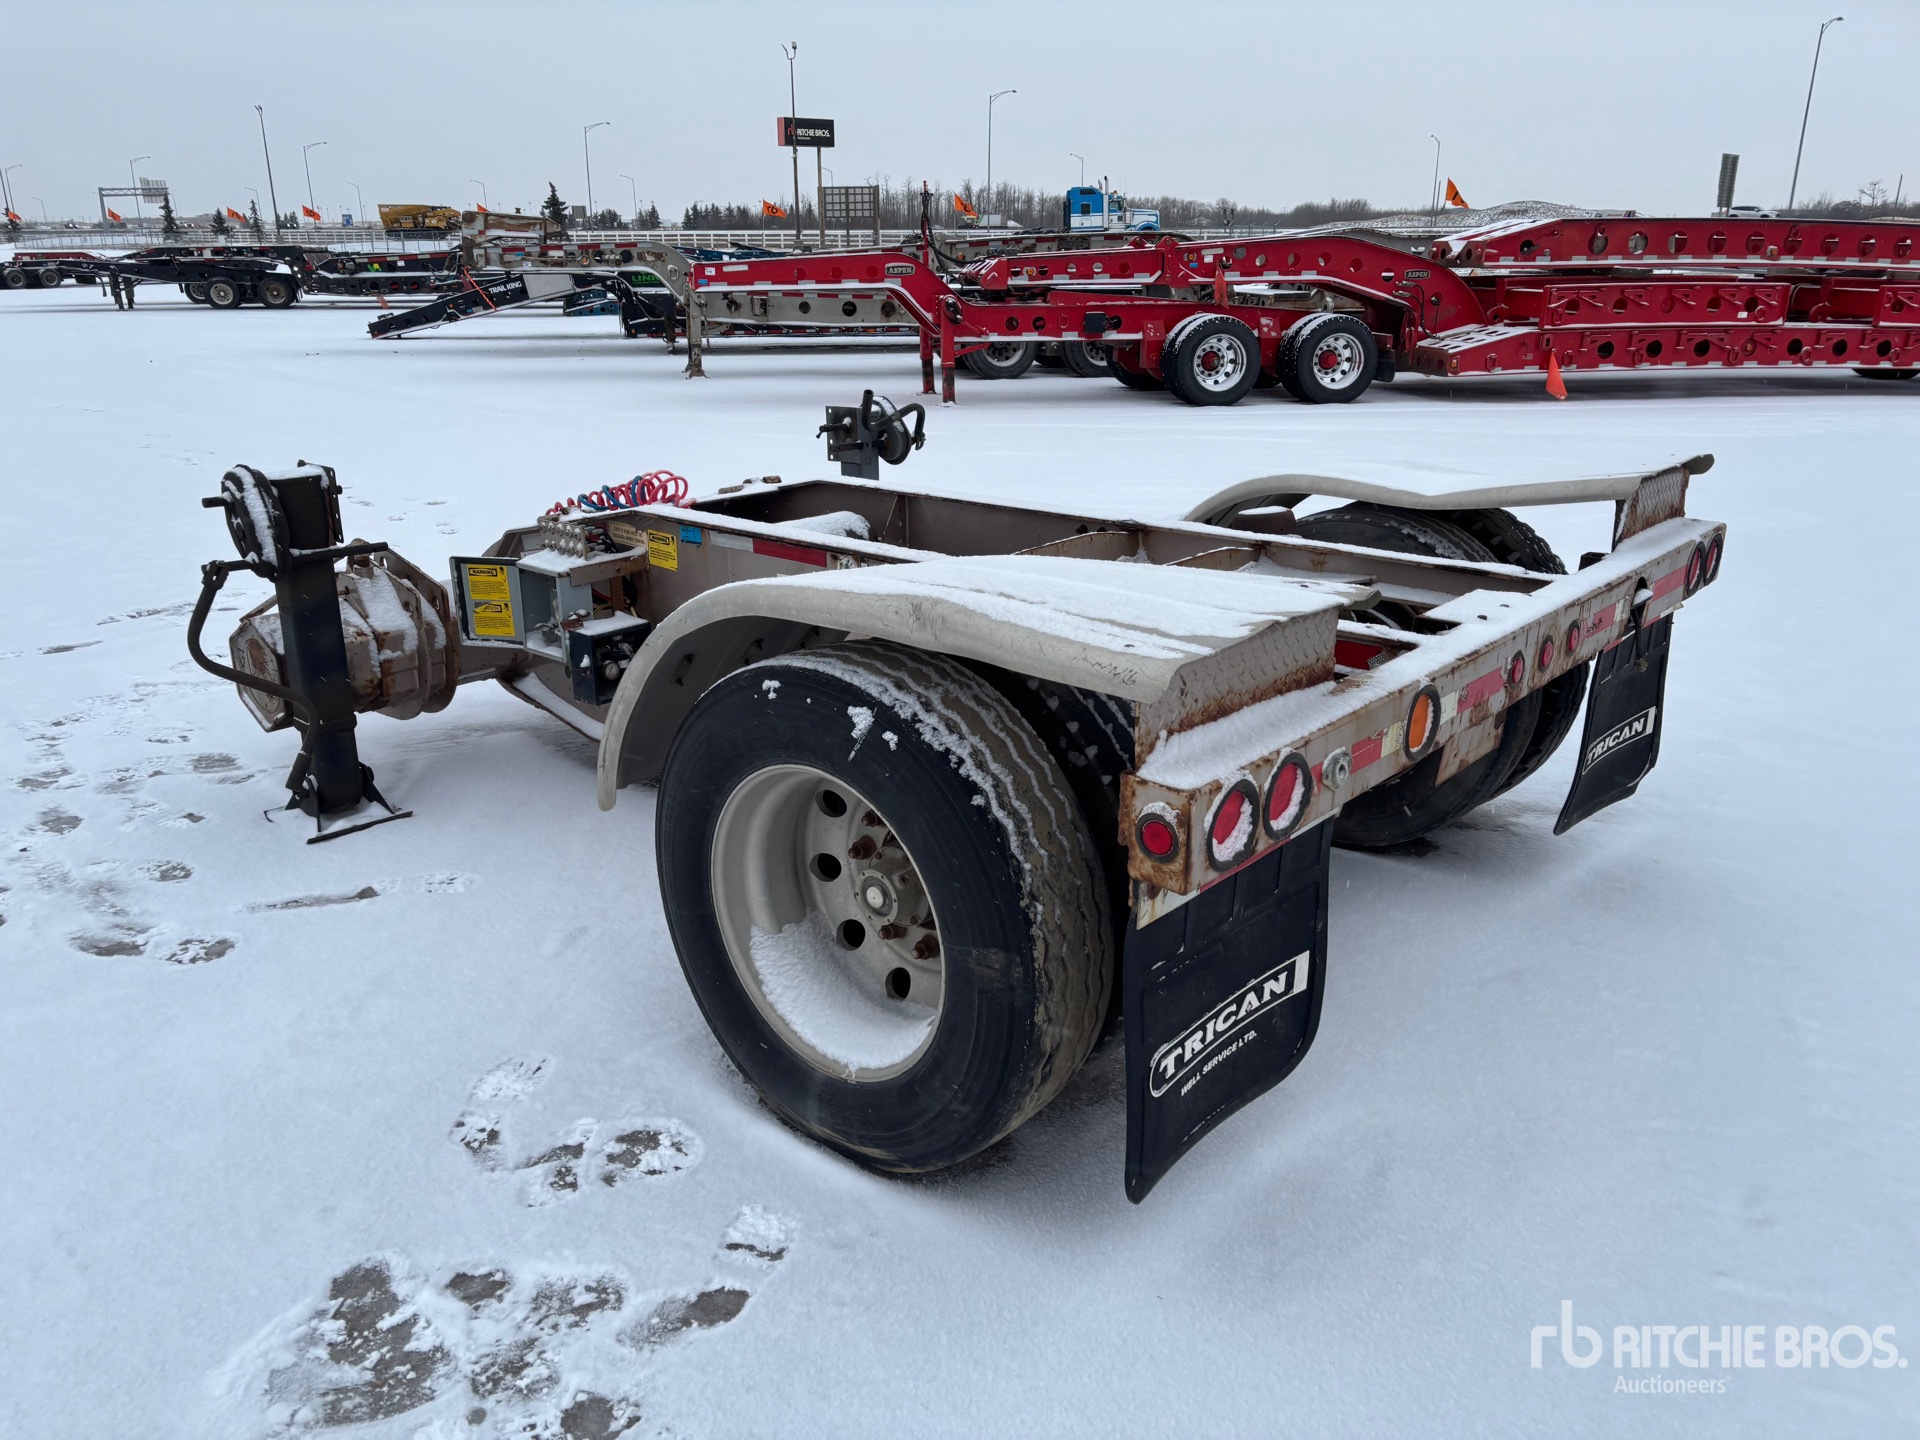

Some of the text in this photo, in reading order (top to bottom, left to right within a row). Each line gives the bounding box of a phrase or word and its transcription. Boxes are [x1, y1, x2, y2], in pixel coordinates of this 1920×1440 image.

[797, 128, 814, 136] RITCHIE
[888, 266, 912, 274] ASPEN
[489, 281, 522, 294] TRAIL KING
[1586, 717, 1646, 766] TRICAN
[1159, 971, 1289, 1080] TRICAN
[1180, 1029, 1257, 1096] WELL SERVICE LTD.
